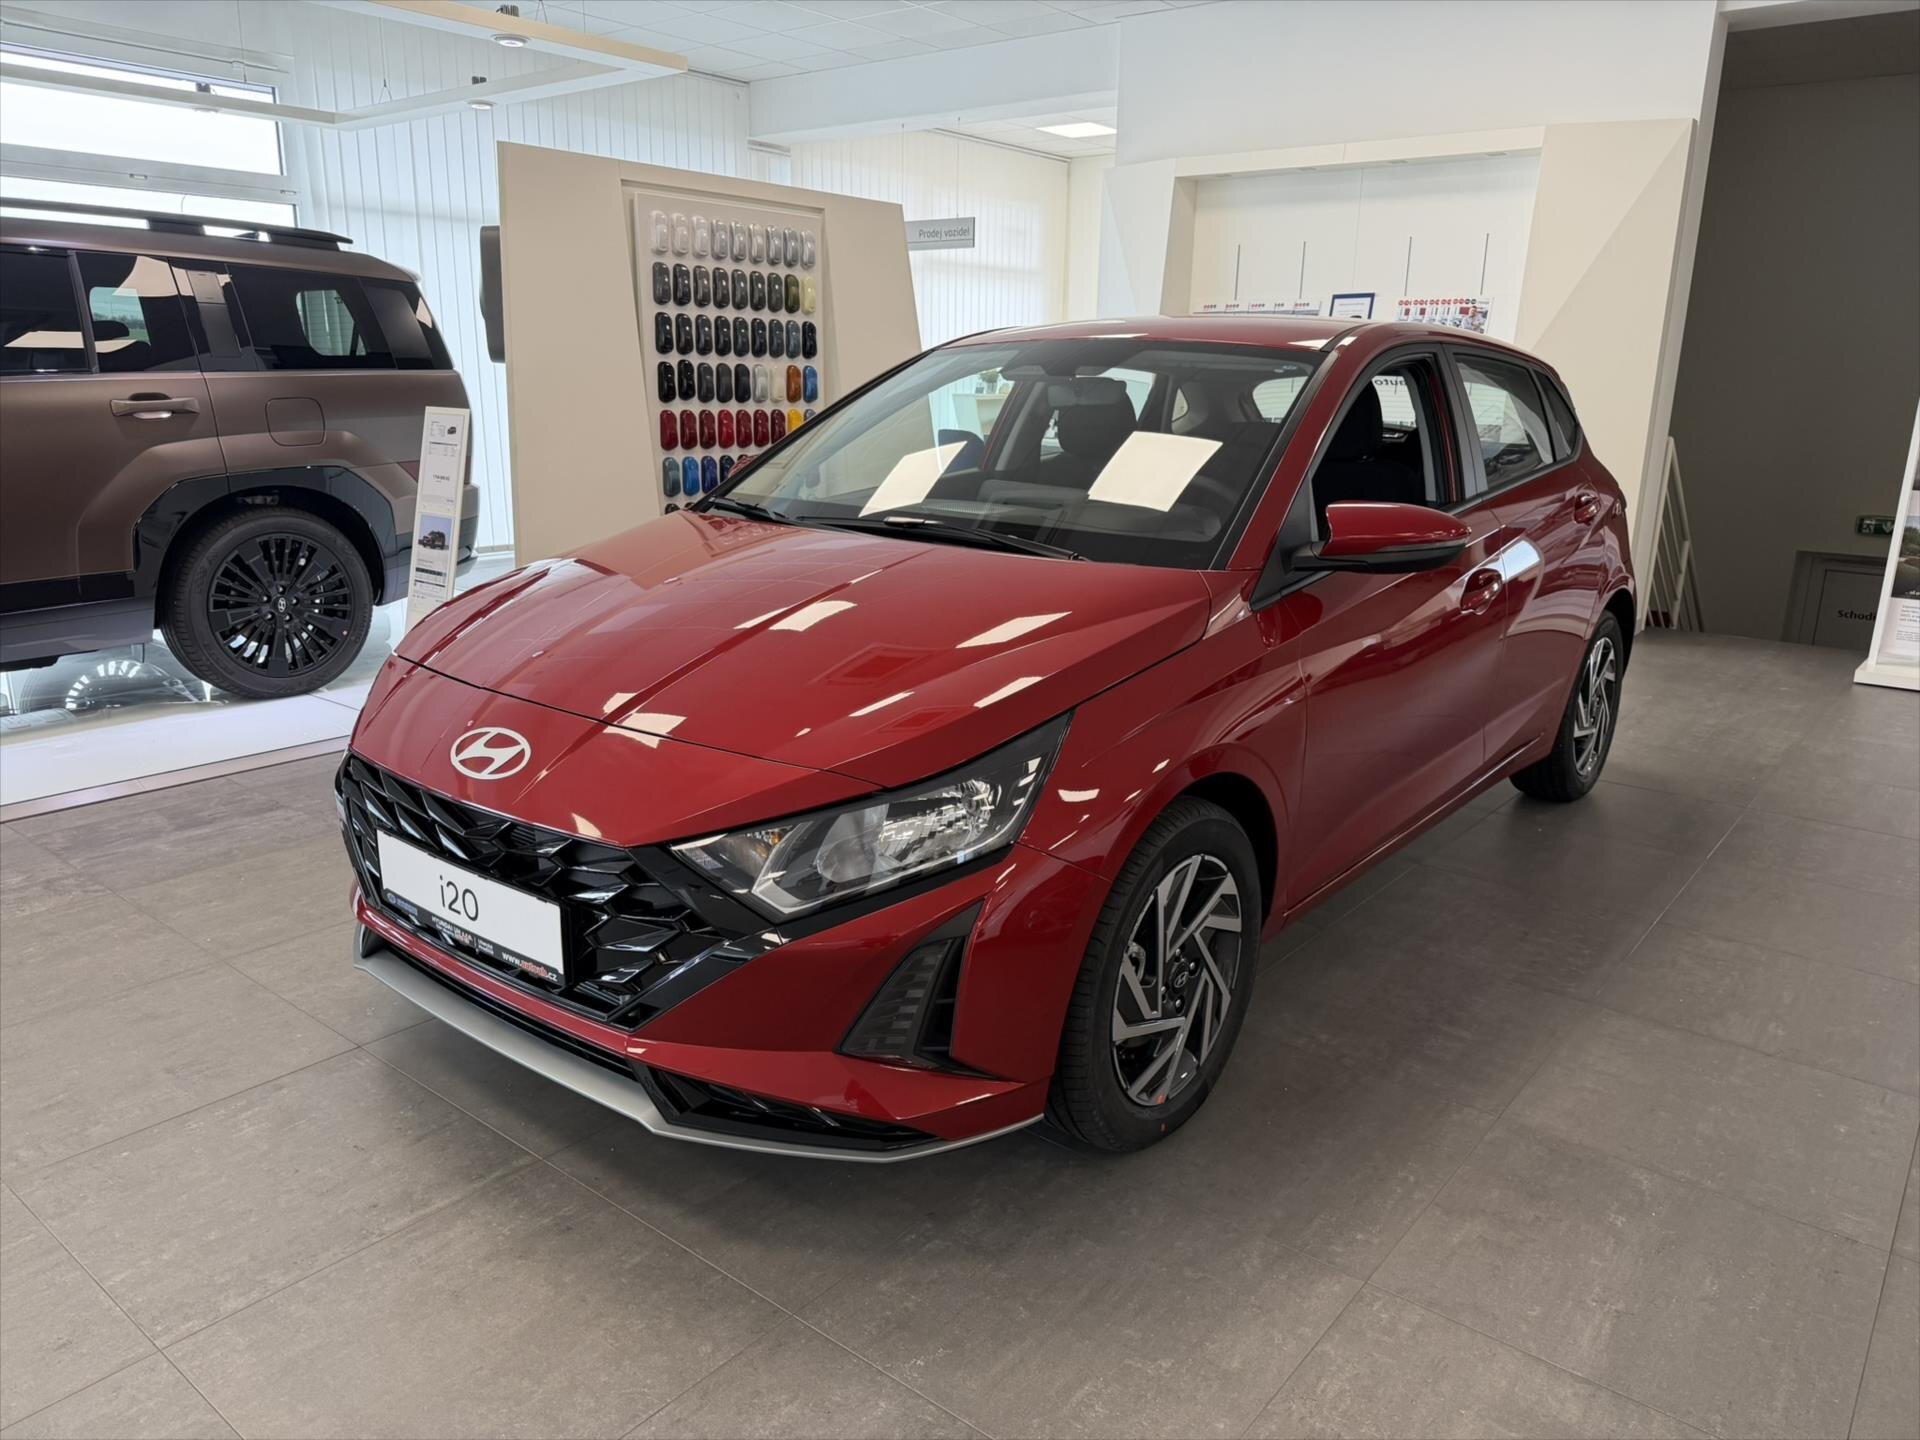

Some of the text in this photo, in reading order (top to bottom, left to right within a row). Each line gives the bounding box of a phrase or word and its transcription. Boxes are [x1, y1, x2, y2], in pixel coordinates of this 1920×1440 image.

[918, 226, 970, 240] Prodej vozidel
[439, 875, 479, 922] i20
